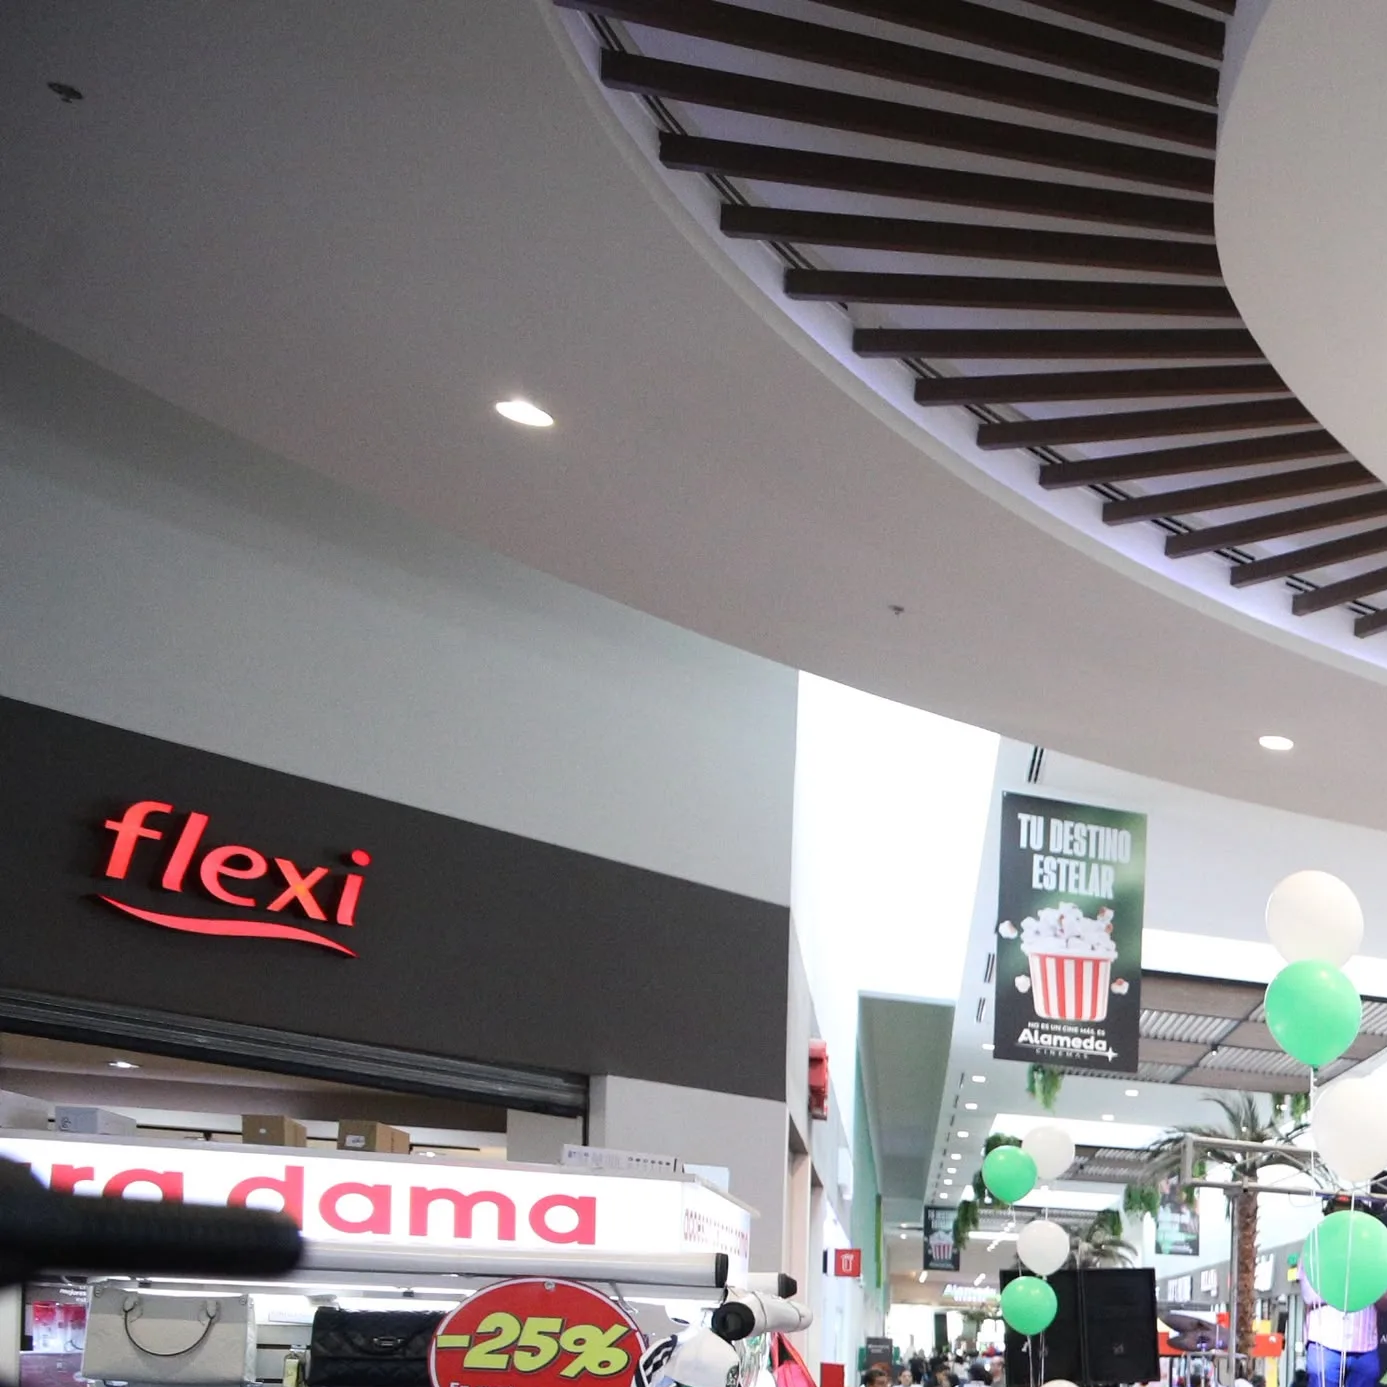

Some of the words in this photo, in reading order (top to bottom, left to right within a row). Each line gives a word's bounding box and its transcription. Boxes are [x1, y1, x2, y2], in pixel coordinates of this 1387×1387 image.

[104, 800, 371, 926] flexi
[1017, 812, 1045, 851] TU
[1049, 817, 1132, 864] DESTINO
[1032, 853, 1115, 900] ESTELAR
[1017, 1028, 1108, 1051] Alameda
[1035, 1048, 1089, 1059] CINEMAS
[226, 1165, 597, 1246] dama
[436, 1311, 630, 1378] -25%
